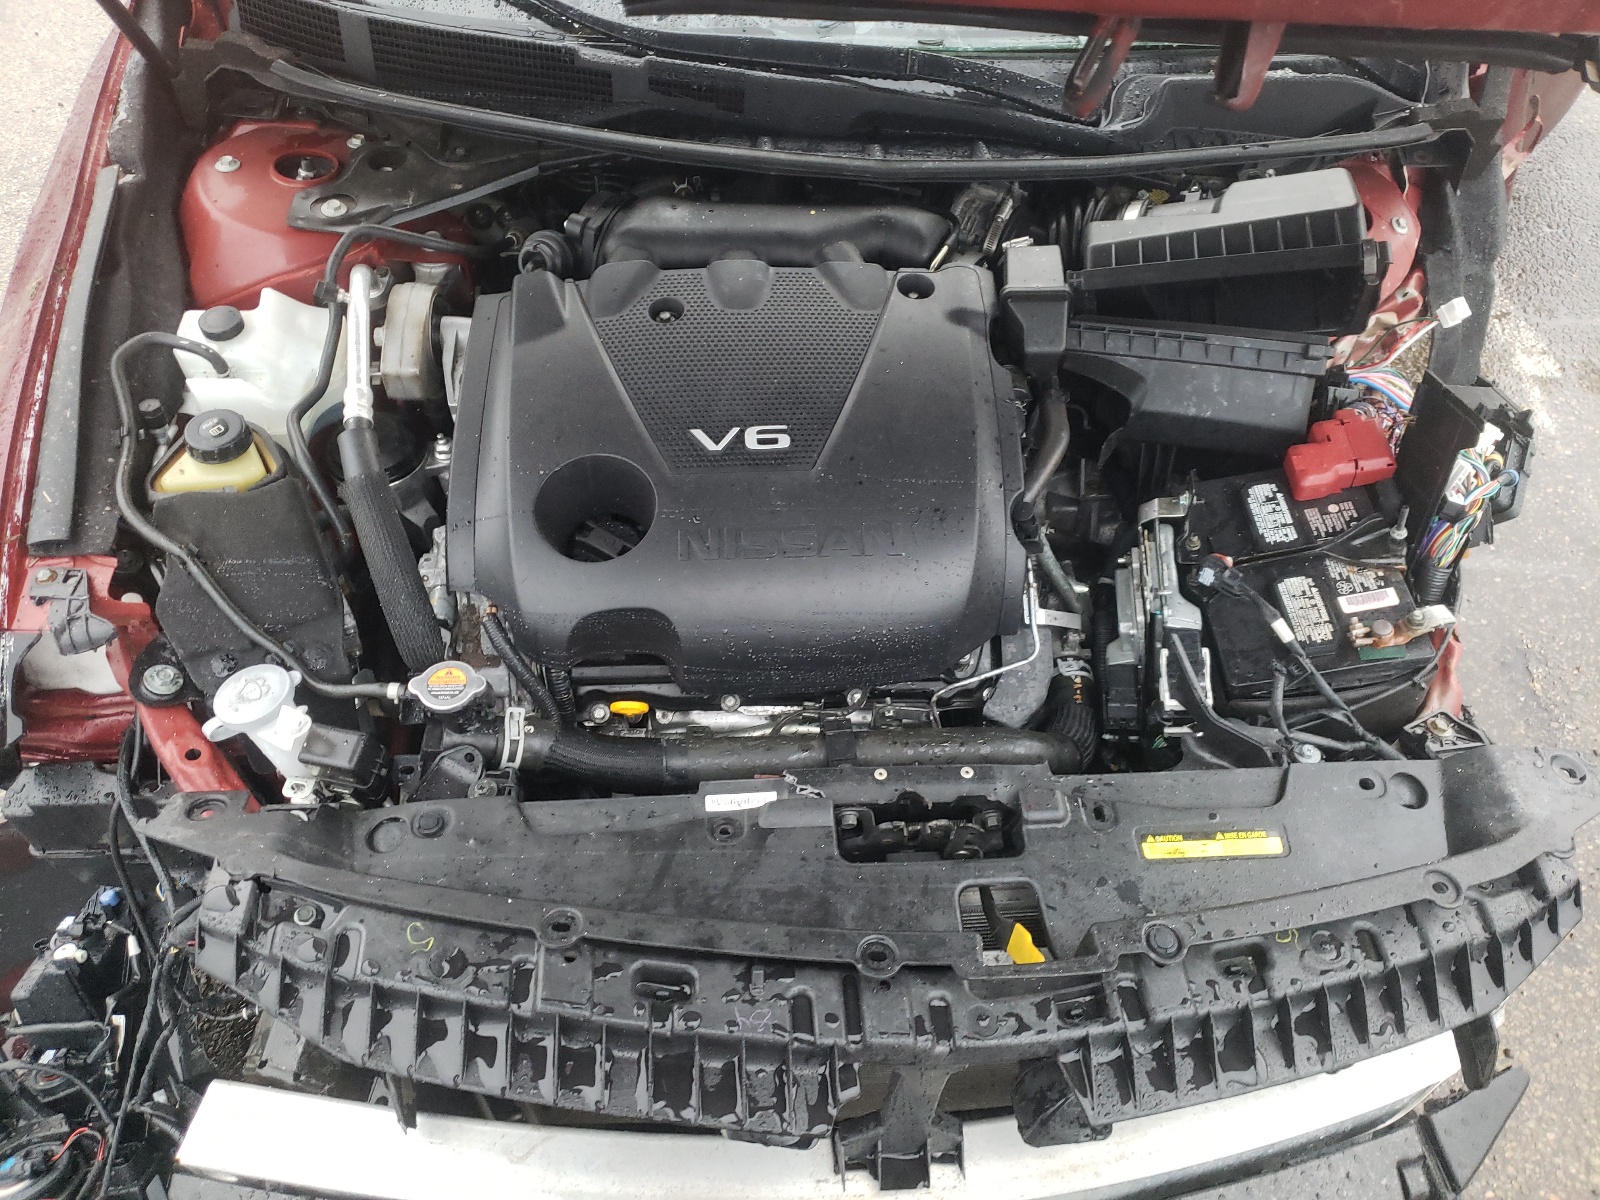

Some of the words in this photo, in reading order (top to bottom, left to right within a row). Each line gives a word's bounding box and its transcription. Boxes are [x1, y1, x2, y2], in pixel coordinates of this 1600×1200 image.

[688, 424, 792, 451] V6
[677, 522, 906, 562] NISSAN
[1155, 833, 1183, 843] CAUTION
